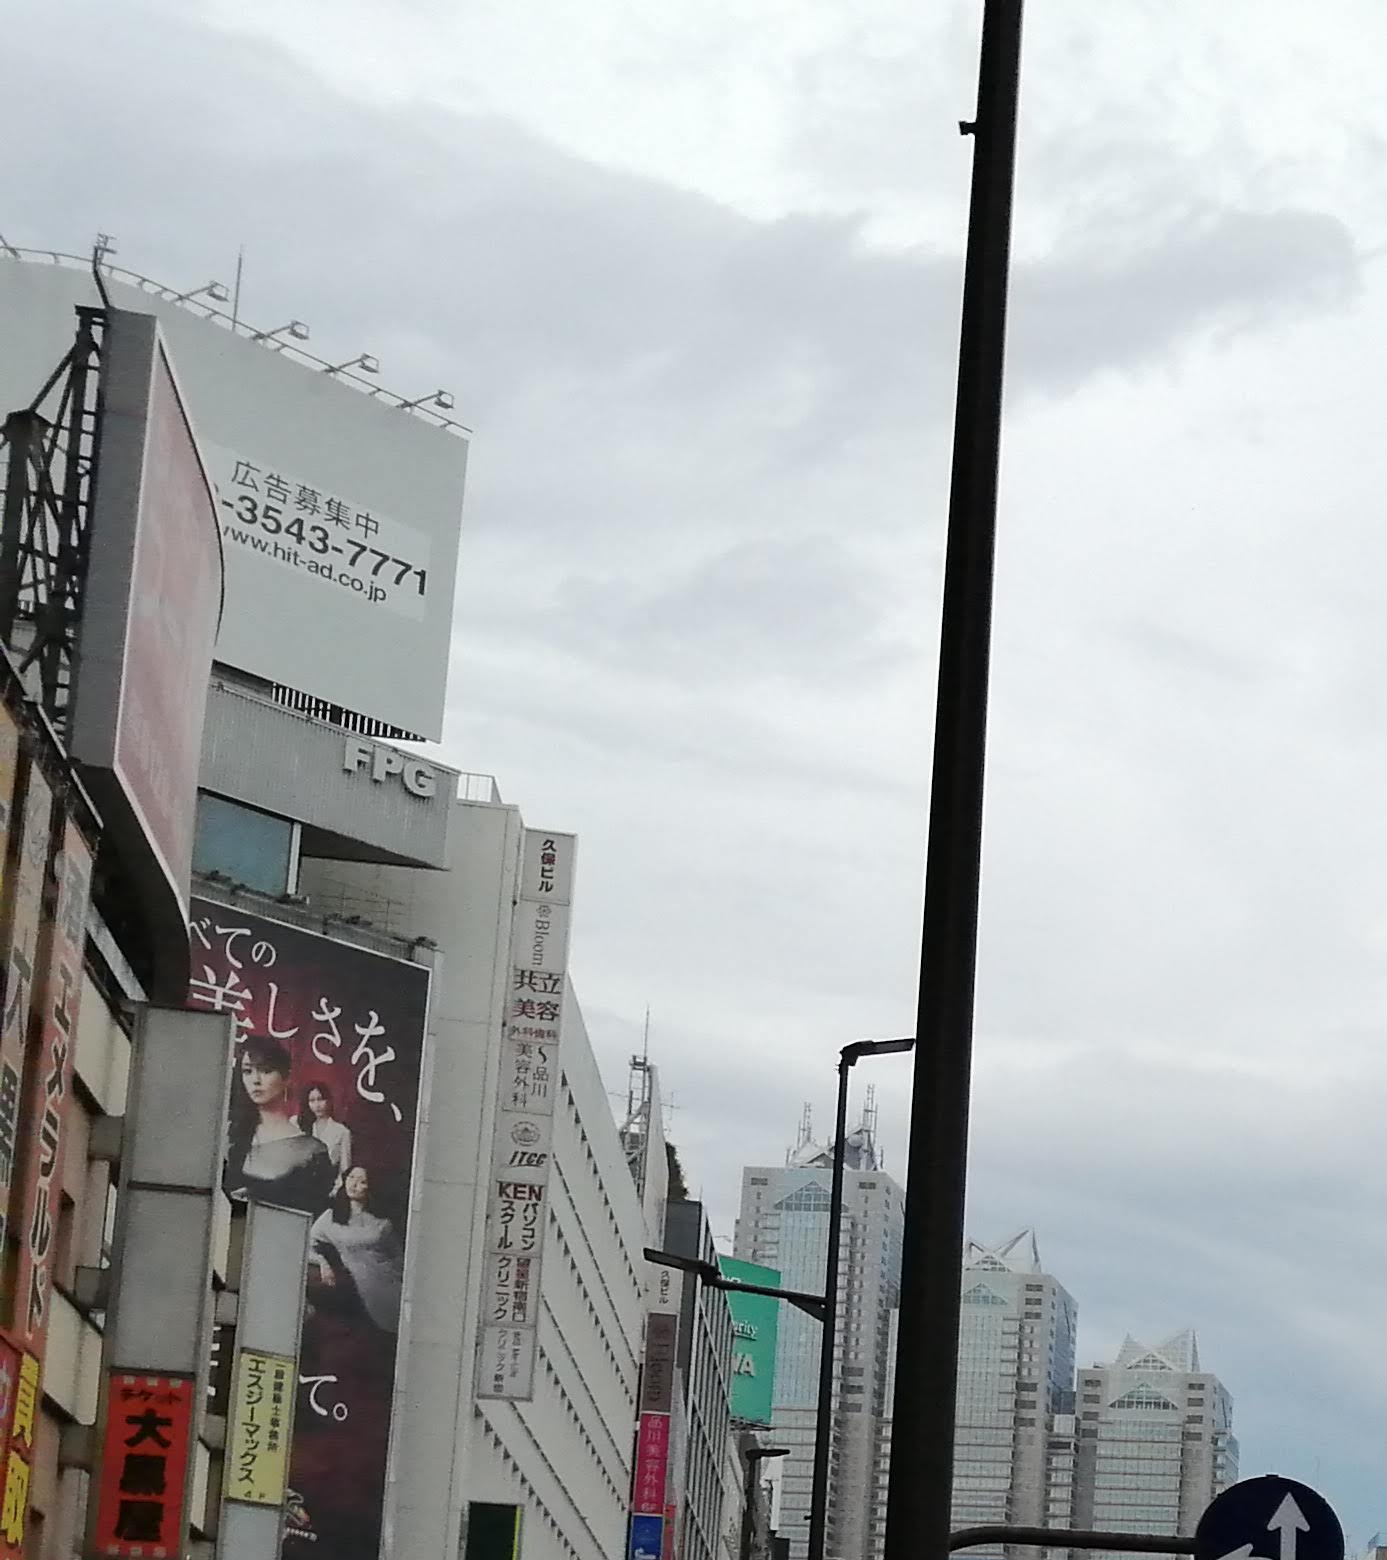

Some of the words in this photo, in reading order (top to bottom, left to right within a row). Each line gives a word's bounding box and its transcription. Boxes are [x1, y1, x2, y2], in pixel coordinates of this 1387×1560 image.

[230, 459, 380, 540] 広告募集中
[216, 483, 428, 596] -3543-7771
[343, 737, 437, 798] FPG
[538, 838, 557, 893] 久保ビル
[531, 919, 551, 967] Bloom
[513, 969, 561, 995] 共立
[511, 999, 560, 1022] 美容
[512, 1041, 532, 1108] 美容外科
[530, 1064, 549, 1099] 品川
[498, 1182, 543, 1202] KEN
[497, 1200, 516, 1250] スクール
[520, 1201, 540, 1252] パソコン
[494, 1255, 511, 1321] クリニック
[238, 1358, 267, 1485] エスジーマックス
